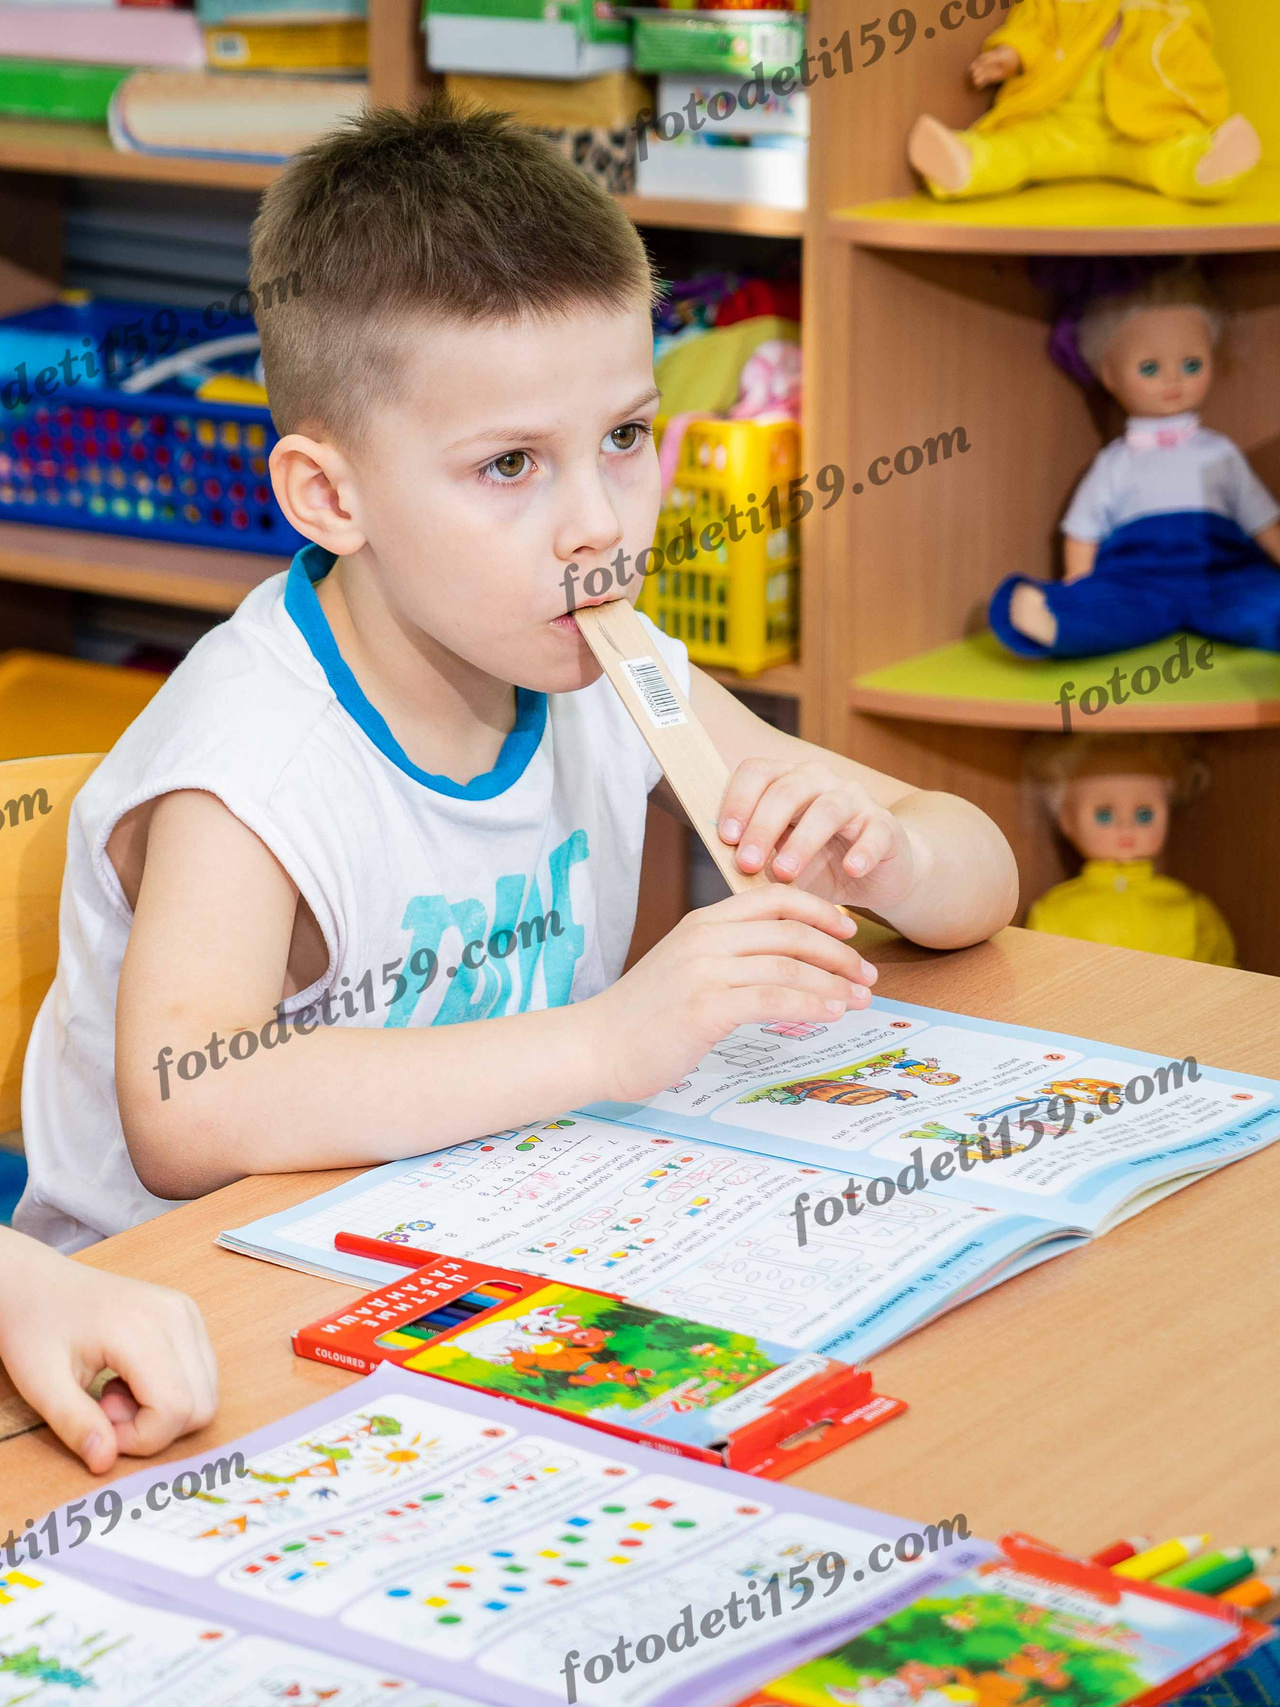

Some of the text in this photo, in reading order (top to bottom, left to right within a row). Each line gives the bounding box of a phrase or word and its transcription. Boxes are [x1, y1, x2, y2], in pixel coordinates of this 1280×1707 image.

[692, 1095, 711, 1107] рав-
[615, 1148, 657, 1170] Подбери
[552, 1173, 613, 1212] пропущенные
[937, 1241, 983, 1268] Занятие
[917, 1274, 936, 1282] 19.
[321, 1262, 463, 1333] КАРАНДАШИ
[366, 1273, 469, 1328] ЦВЕТНЫЕ
[857, 1287, 917, 1327] Измерение
[315, 1348, 365, 1368] COLOURED
